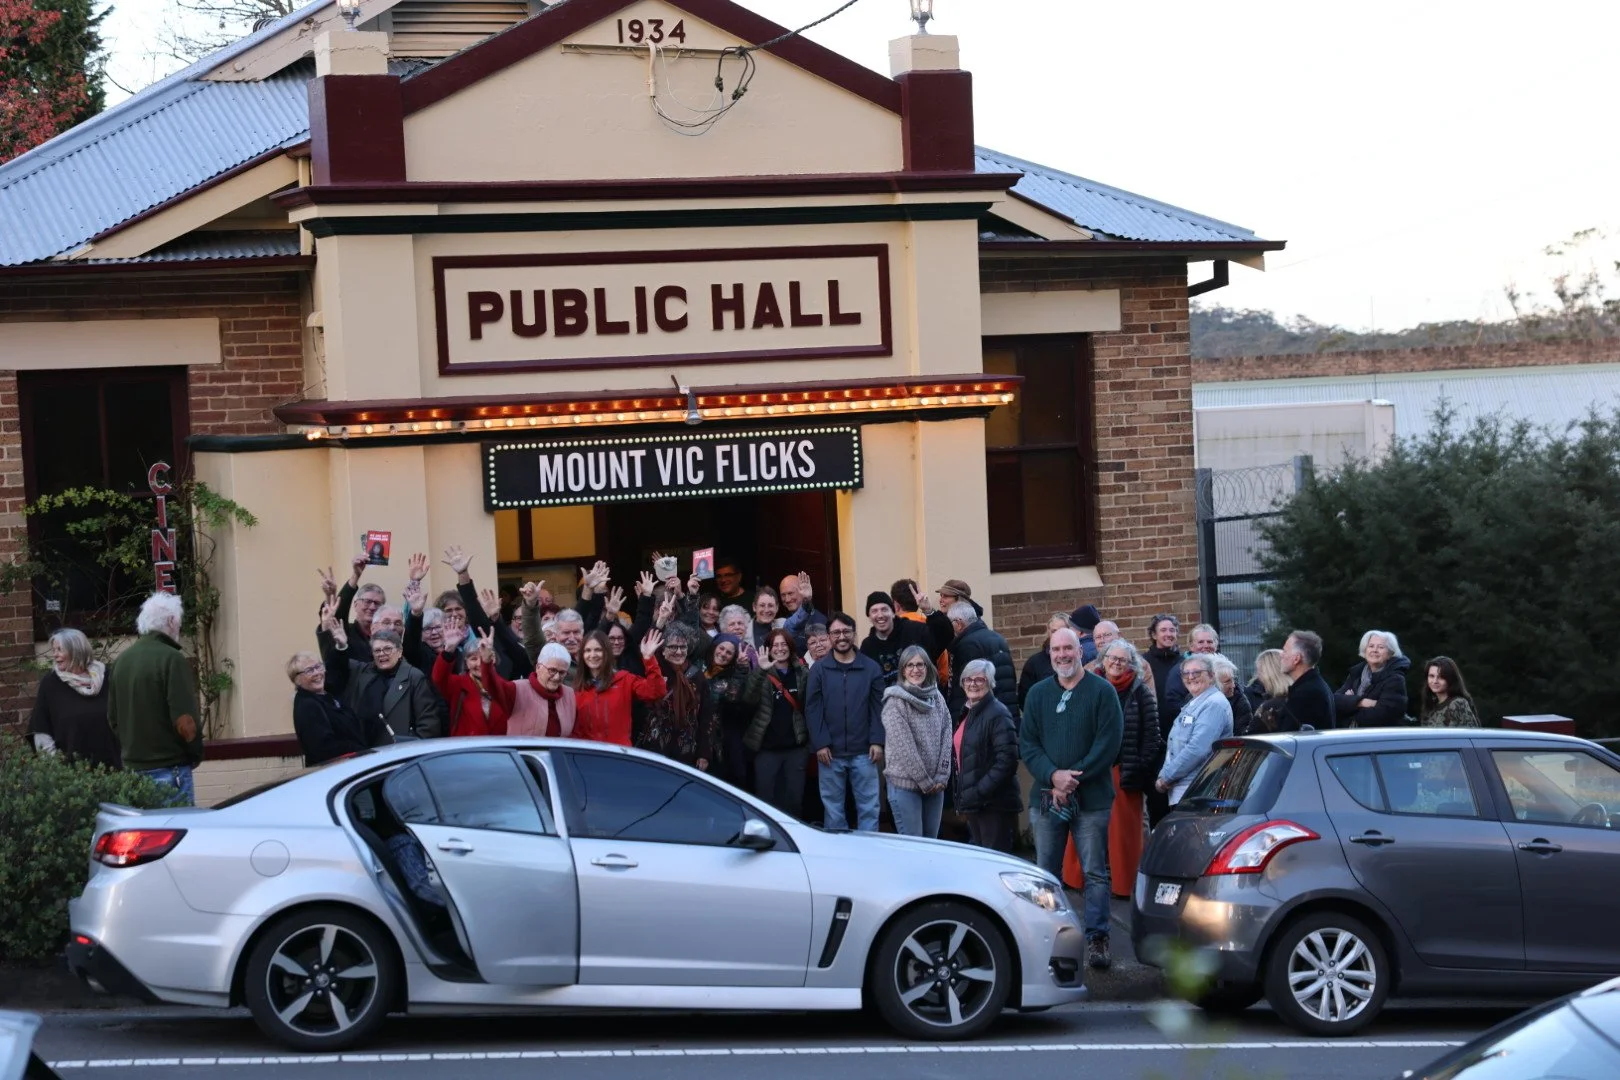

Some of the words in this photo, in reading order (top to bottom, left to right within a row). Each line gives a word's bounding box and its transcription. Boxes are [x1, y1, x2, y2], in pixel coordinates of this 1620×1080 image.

[616, 18, 687, 45] 1934
[466, 284, 689, 341] PUBLIC
[710, 279, 863, 331] HALL
[538, 449, 647, 493] MOUNT
[654, 445, 704, 486] VIC
[714, 439, 816, 483] FLICKS
[147, 462, 177, 594] CINE
